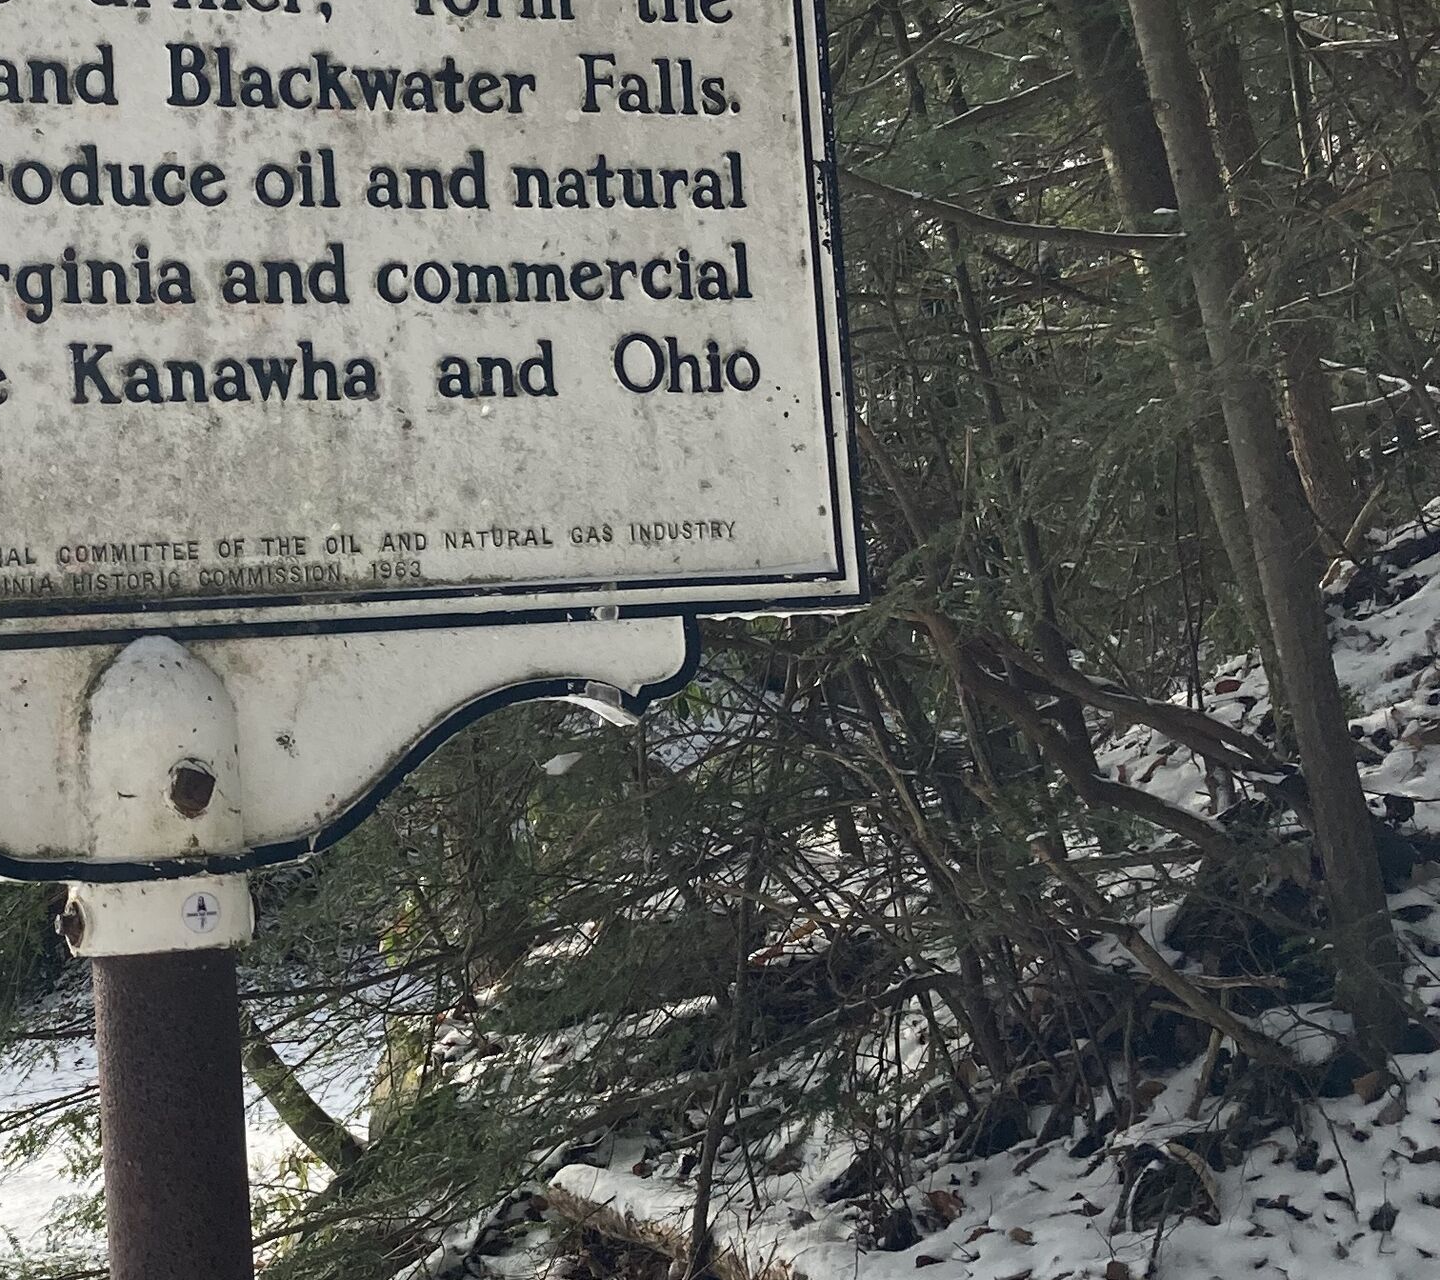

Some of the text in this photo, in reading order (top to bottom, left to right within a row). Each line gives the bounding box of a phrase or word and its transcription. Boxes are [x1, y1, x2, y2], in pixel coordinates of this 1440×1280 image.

[165, 42, 535, 114] Blackwater
[578, 52, 742, 116] Falls.
[254, 150, 340, 209] oil
[366, 150, 489, 210] and
[512, 151, 747, 210] natural
[221, 243, 350, 306] and
[376, 242, 753, 305] commercial
[67, 341, 380, 405] Kanawha
[437, 340, 559, 399] and
[613, 332, 761, 395] Ohio
[58, 540, 200, 565] COMMITTEE
[218, 538, 245, 559] OF
[260, 536, 307, 556] THE
[325, 534, 362, 555] OIL
[380, 533, 428, 553] AND
[443, 526, 554, 550] NATURAL
[570, 522, 614, 545] GAS
[628, 520, 738, 543] INDUSTRY
[73, 570, 180, 593] HISTORIC
[368, 561, 422, 580] 1963
